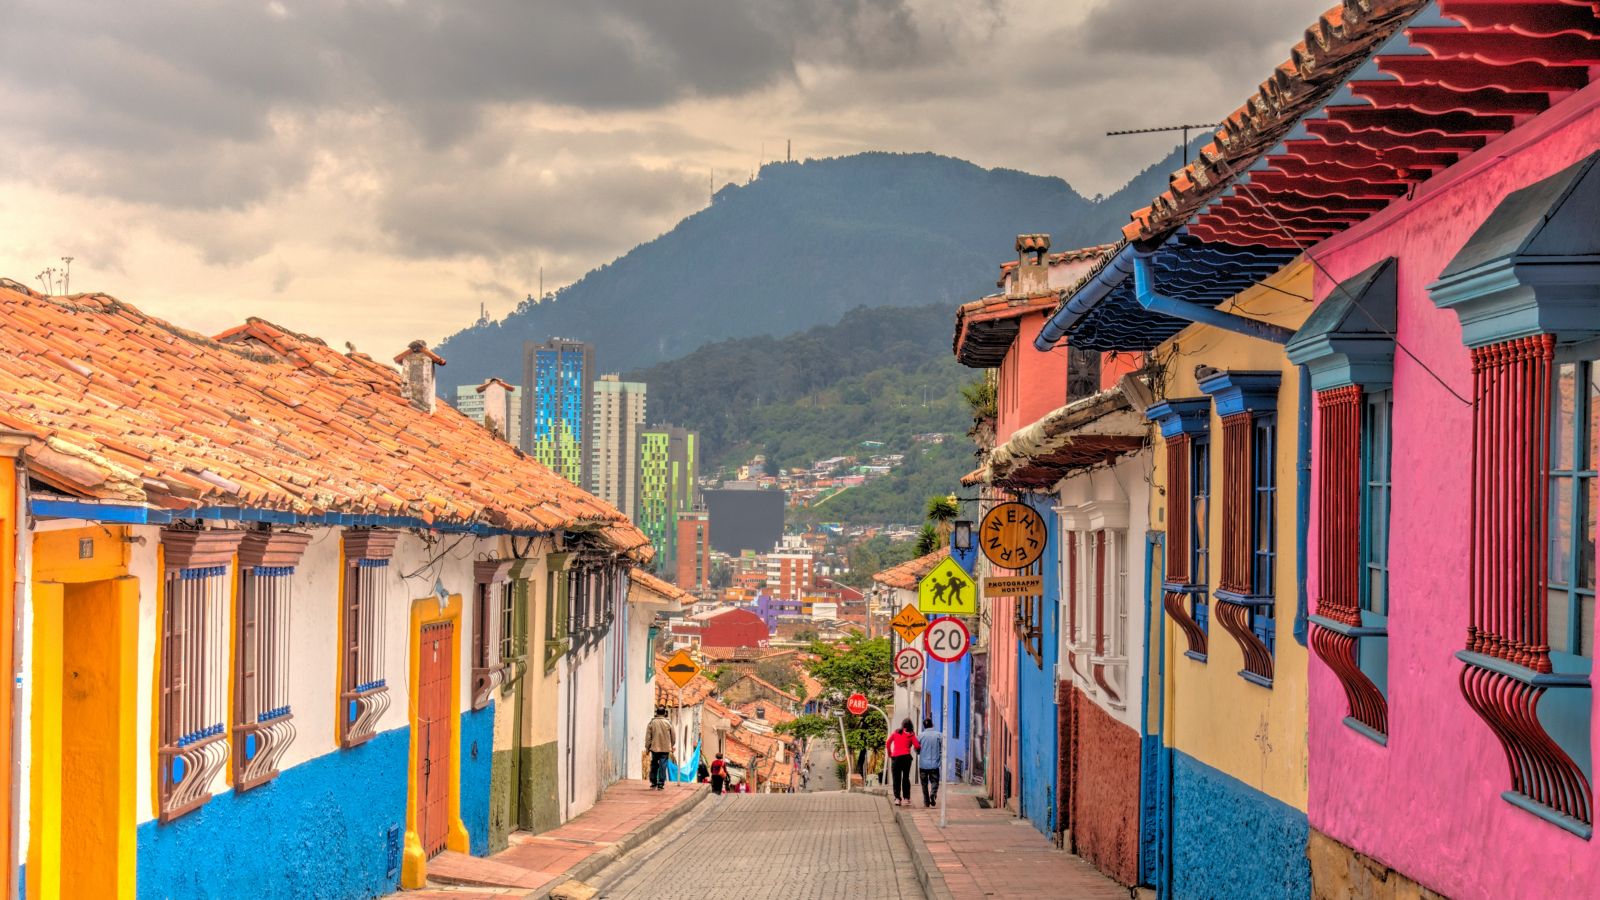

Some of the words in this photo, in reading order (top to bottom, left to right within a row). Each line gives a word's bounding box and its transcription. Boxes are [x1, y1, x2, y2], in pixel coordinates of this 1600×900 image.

[988, 580, 1039, 588] PHOTOGRAPHY
[933, 629, 961, 650] 20
[899, 655, 919, 669] 20
[849, 699, 866, 709] PARE
